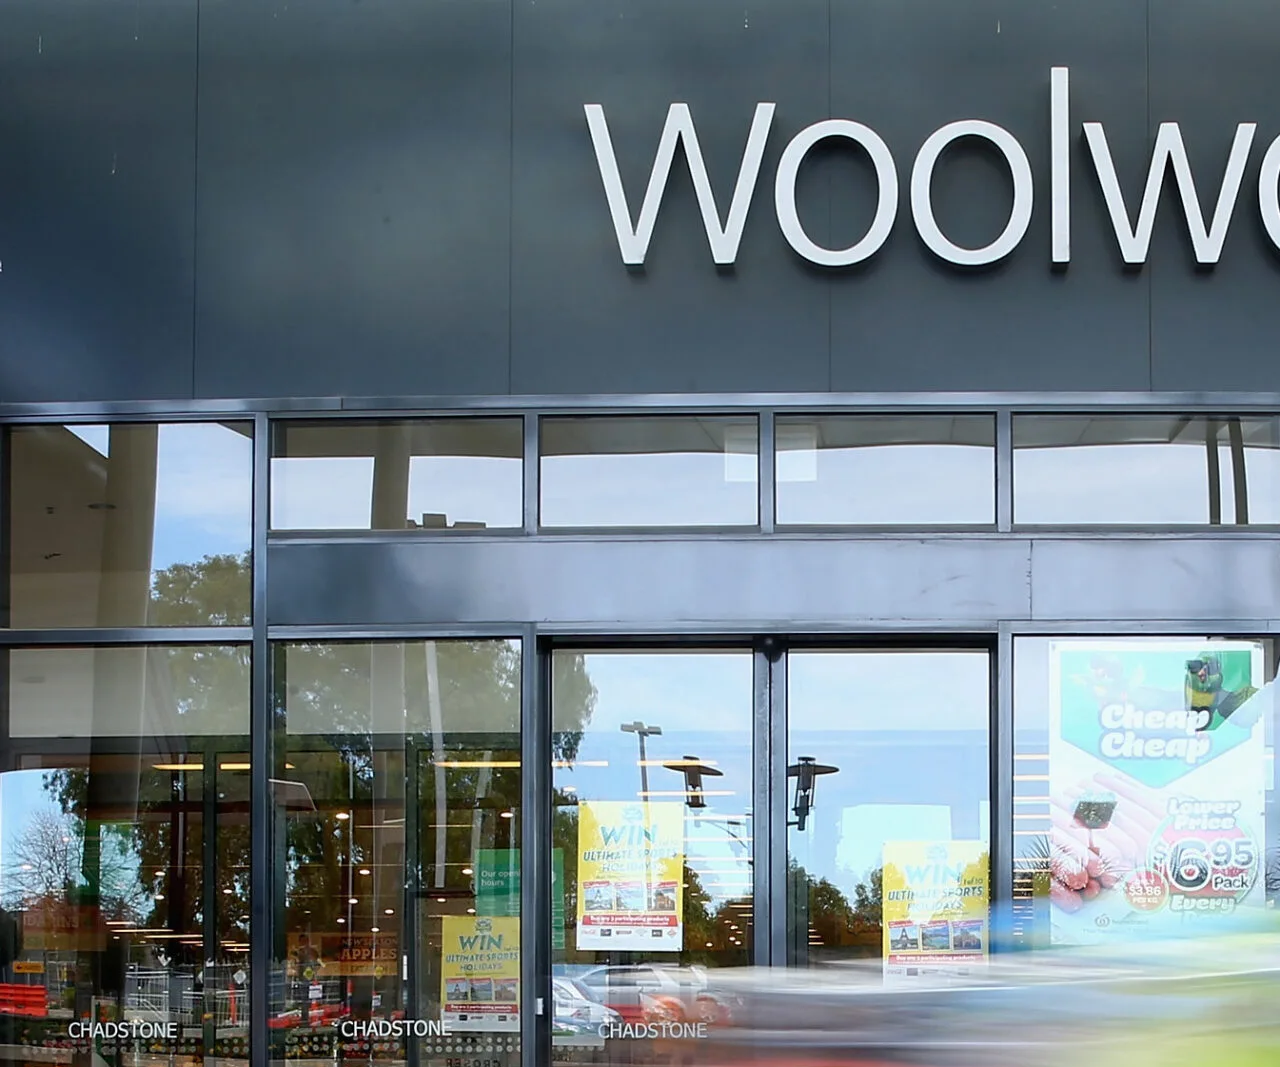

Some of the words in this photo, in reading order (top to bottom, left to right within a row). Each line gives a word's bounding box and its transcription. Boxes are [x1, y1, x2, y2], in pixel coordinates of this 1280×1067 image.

[1101, 704, 1210, 736] Cheap
[1100, 731, 1210, 764] Cheap
[1174, 814, 1236, 830] Price
[600, 825, 657, 846] WIN
[905, 864, 965, 885] WIN
[1213, 876, 1249, 889] Pack
[459, 934, 504, 951] WIN
[341, 947, 398, 960] APPLES
[68, 1022, 178, 1038] CHADSTONE
[341, 1020, 453, 1037] CHADSTONE
[598, 1022, 708, 1039] CHADSTONE
